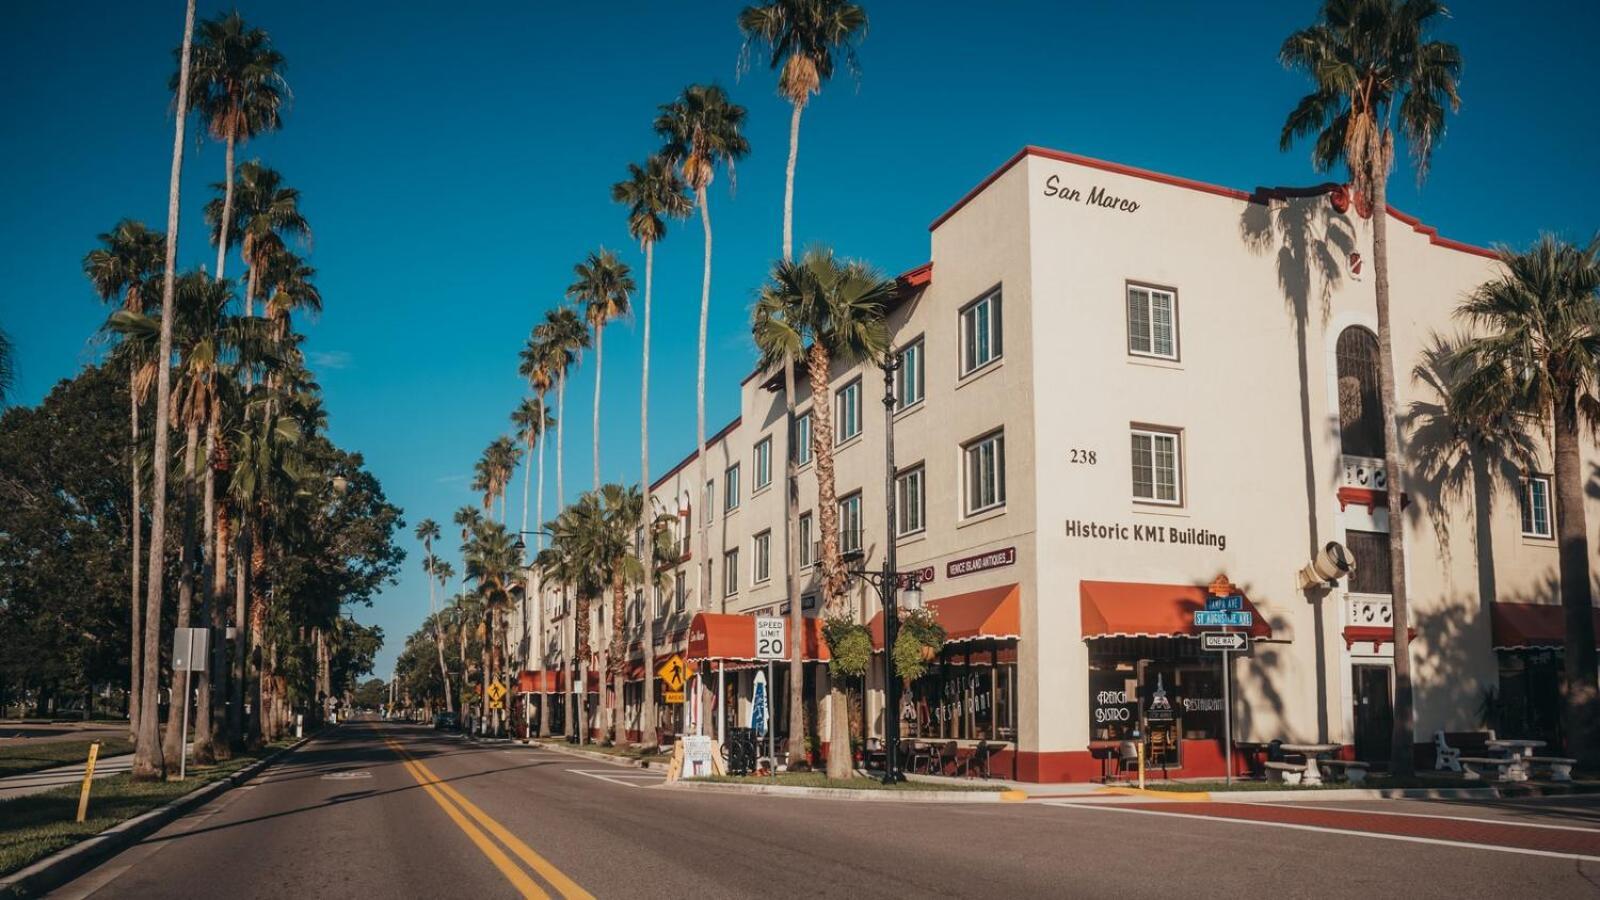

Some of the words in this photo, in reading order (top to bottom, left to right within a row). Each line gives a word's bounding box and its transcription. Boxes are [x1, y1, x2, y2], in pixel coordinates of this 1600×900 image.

[1044, 174, 1080, 202] San
[1086, 186, 1140, 213] Marco
[1071, 449, 1097, 465] 238
[1065, 520, 1129, 540] Historic
[1134, 525, 1165, 543] KMI
[1169, 527, 1226, 550] Building
[983, 552, 1006, 567] ANTIQUES
[1228, 598, 1238, 609] AVE
[759, 621, 782, 629] SPEED
[1197, 614, 1204, 624] ST
[1240, 614, 1250, 625] AVE
[761, 630, 780, 638] LIMIT
[1222, 637, 1234, 645] WAY
[759, 639, 783, 654] 20
[1097, 691, 1127, 705] FRENCH
[1095, 708, 1130, 722] BISTRO
